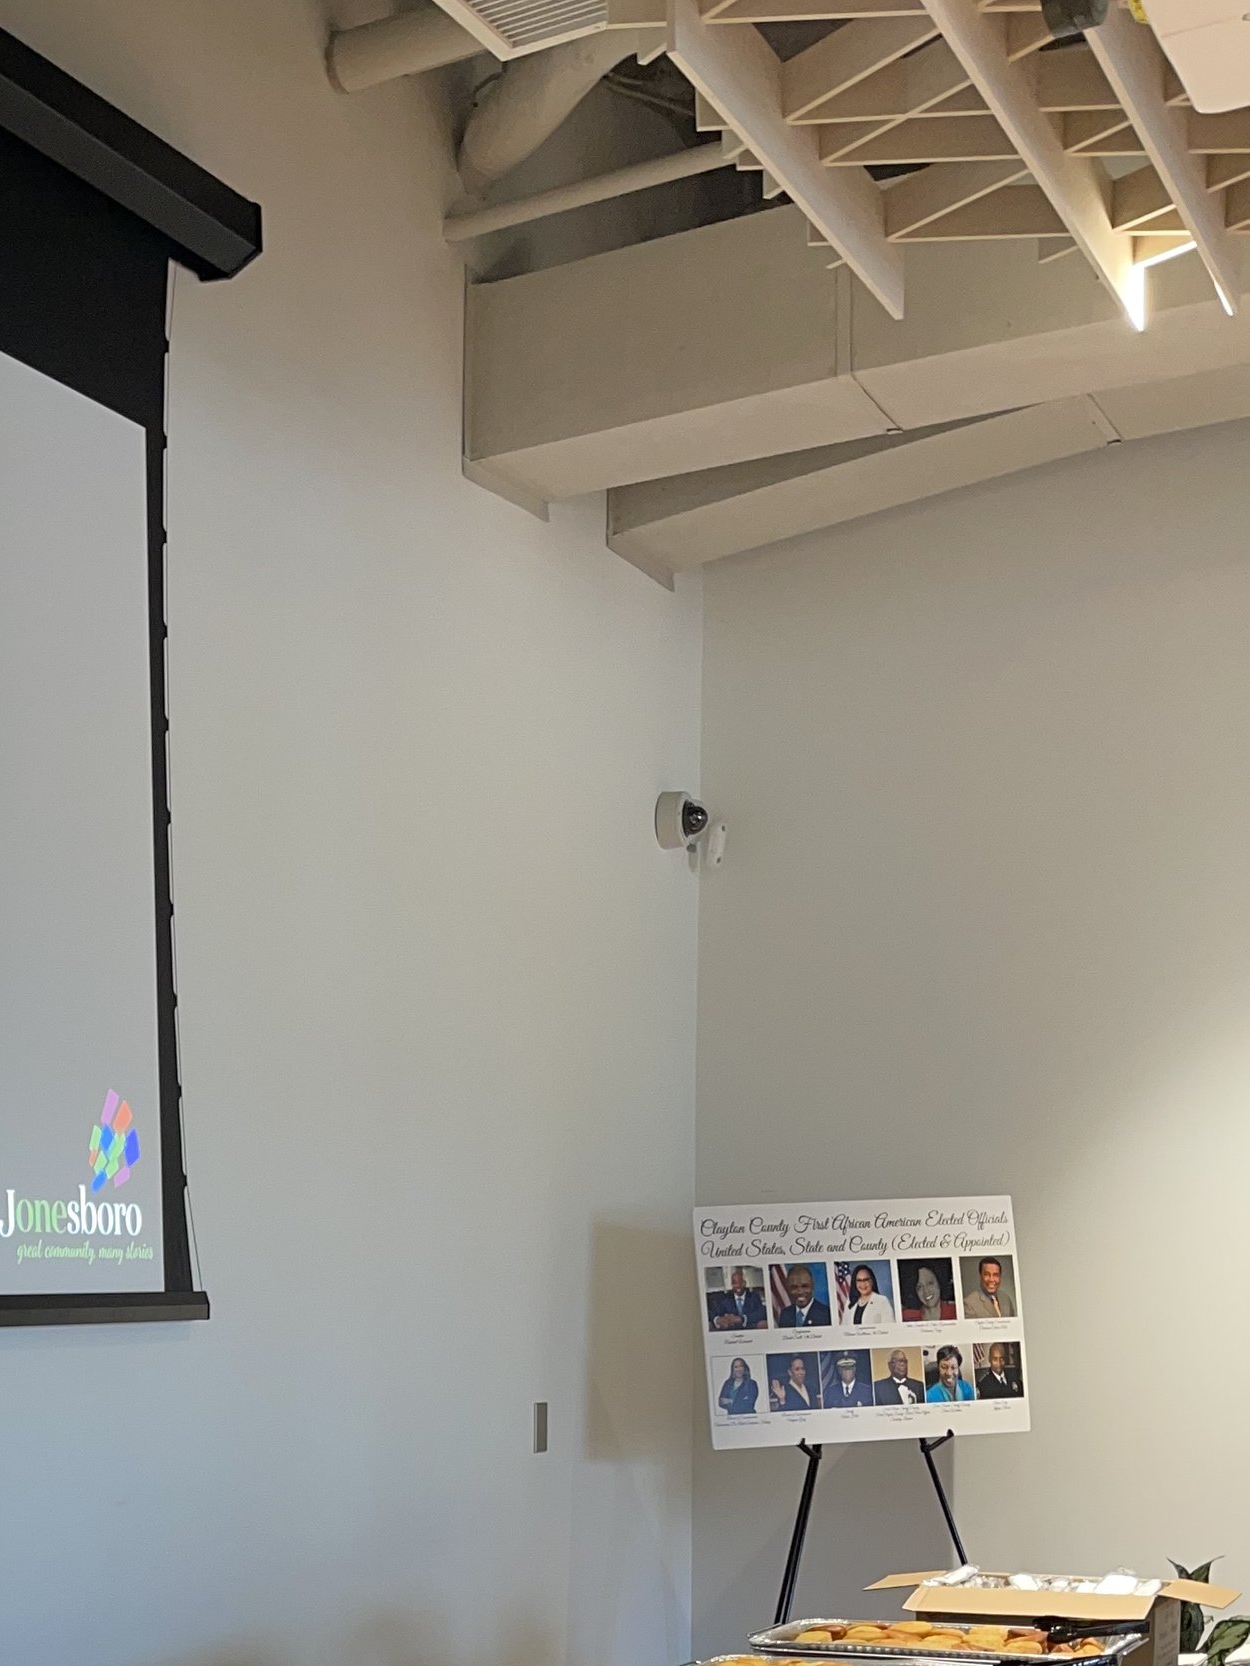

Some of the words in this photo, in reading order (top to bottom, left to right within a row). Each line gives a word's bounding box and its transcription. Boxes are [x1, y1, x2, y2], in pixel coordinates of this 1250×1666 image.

[700, 1218, 745, 1240] Clayton
[749, 1216, 789, 1237] County
[794, 1215, 829, 1233] First
[831, 1213, 870, 1235] African
[874, 1211, 922, 1230] American
[925, 1209, 965, 1227] Elected
[967, 1209, 1008, 1231] Officials
[17, 1239, 42, 1264] great
[99, 1247, 123, 1265] many
[125, 1241, 154, 1260] stories
[701, 1240, 744, 1258] United
[789, 1237, 823, 1255] State
[827, 1238, 847, 1252] and
[849, 1235, 887, 1256] County
[891, 1232, 938, 1251] (Elected
[940, 1234, 950, 1249] &
[953, 1231, 1011, 1252] Appointed)
